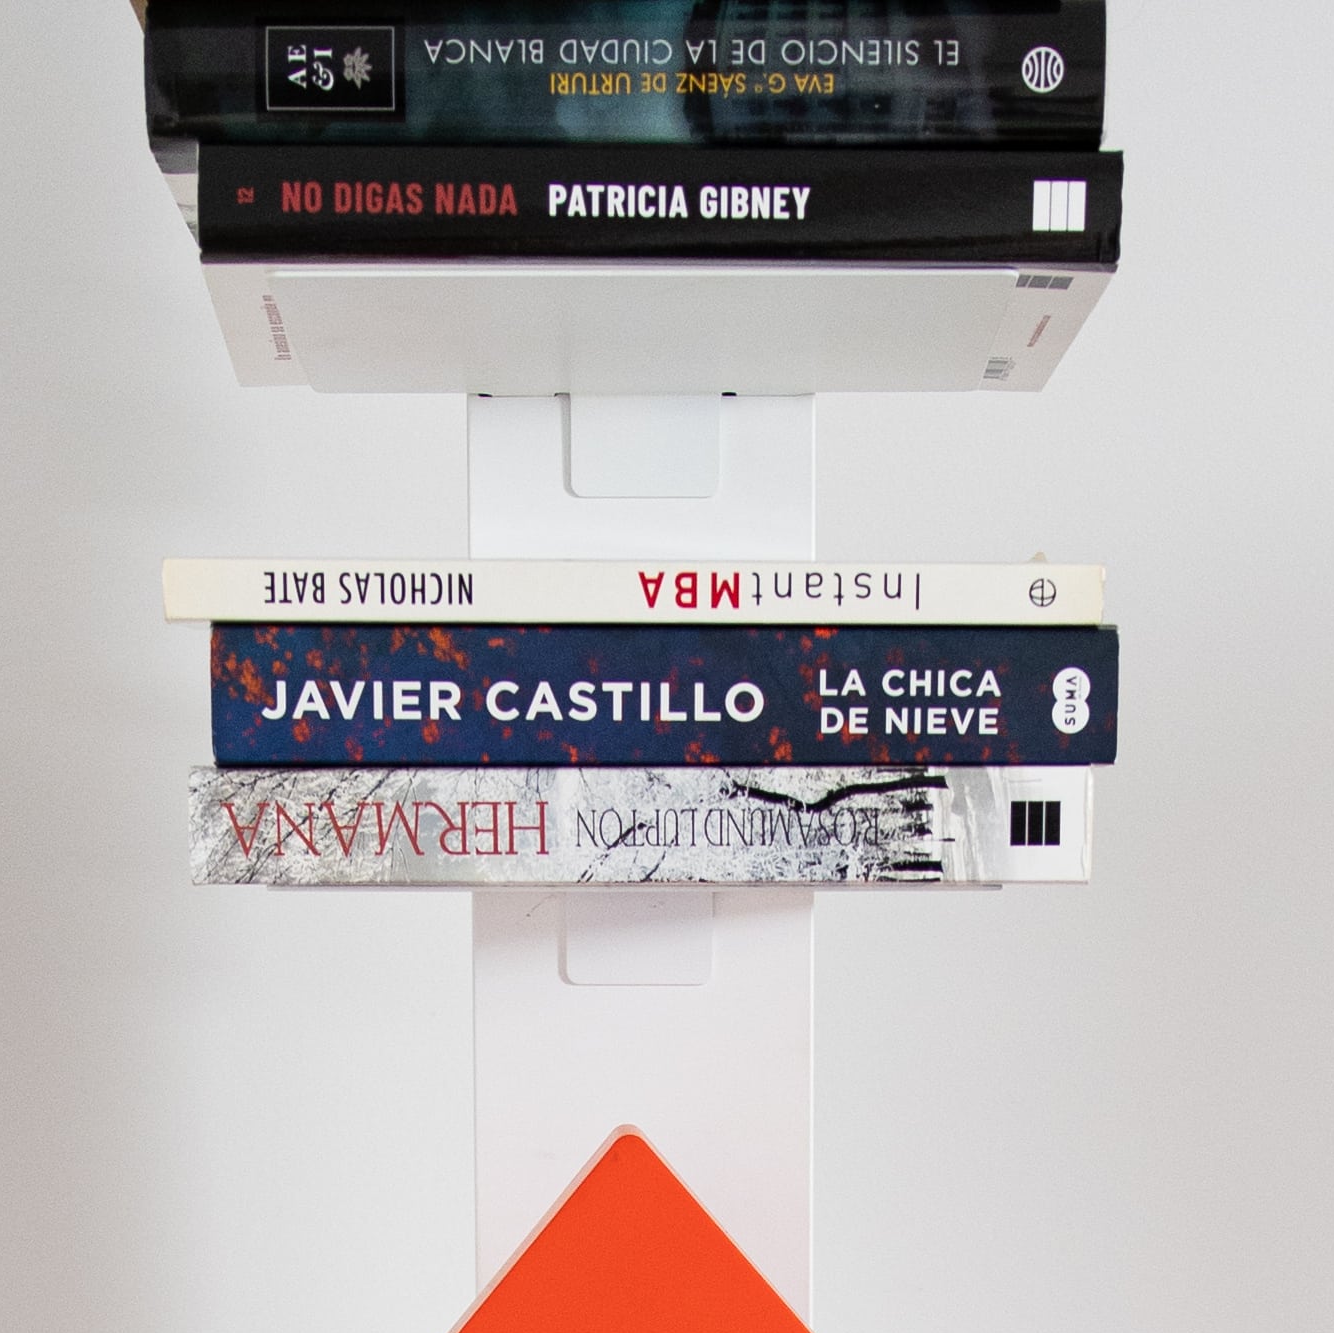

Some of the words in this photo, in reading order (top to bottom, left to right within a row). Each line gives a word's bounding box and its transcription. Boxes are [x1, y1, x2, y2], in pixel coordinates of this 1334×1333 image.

[424, 38, 544, 64] BLANCA
[559, 39, 672, 65] CIUDAD
[685, 39, 717, 65] LA
[731, 39, 766, 66] DE
[781, 39, 919, 66] SILENCIO
[934, 40, 960, 66] EL
[550, 72, 631, 95] URTURI
[642, 73, 667, 94] DE
[676, 73, 746, 98] SÁENZ
[796, 73, 835, 94] EVA
[282, 181, 321, 214] NO
[334, 181, 423, 214] DIGAS
[435, 182, 518, 216] NADA
[548, 184, 688, 218] PATRICIA
[700, 186, 810, 220] GIBNEY
[264, 571, 325, 604] BATE
[339, 571, 473, 604] NICHOLAS
[819, 669, 865, 697] LA
[881, 669, 1002, 698] CHICA
[262, 680, 462, 721] JAVIER
[485, 681, 764, 722] CASTILLO
[1065, 674, 1078, 726] SUMA
[821, 708, 869, 735] DE
[885, 708, 999, 735] NIEVE
[221, 801, 549, 859] HERMANA
[576, 808, 697, 847] LUPTON
[704, 808, 880, 847] ROSAMUND
